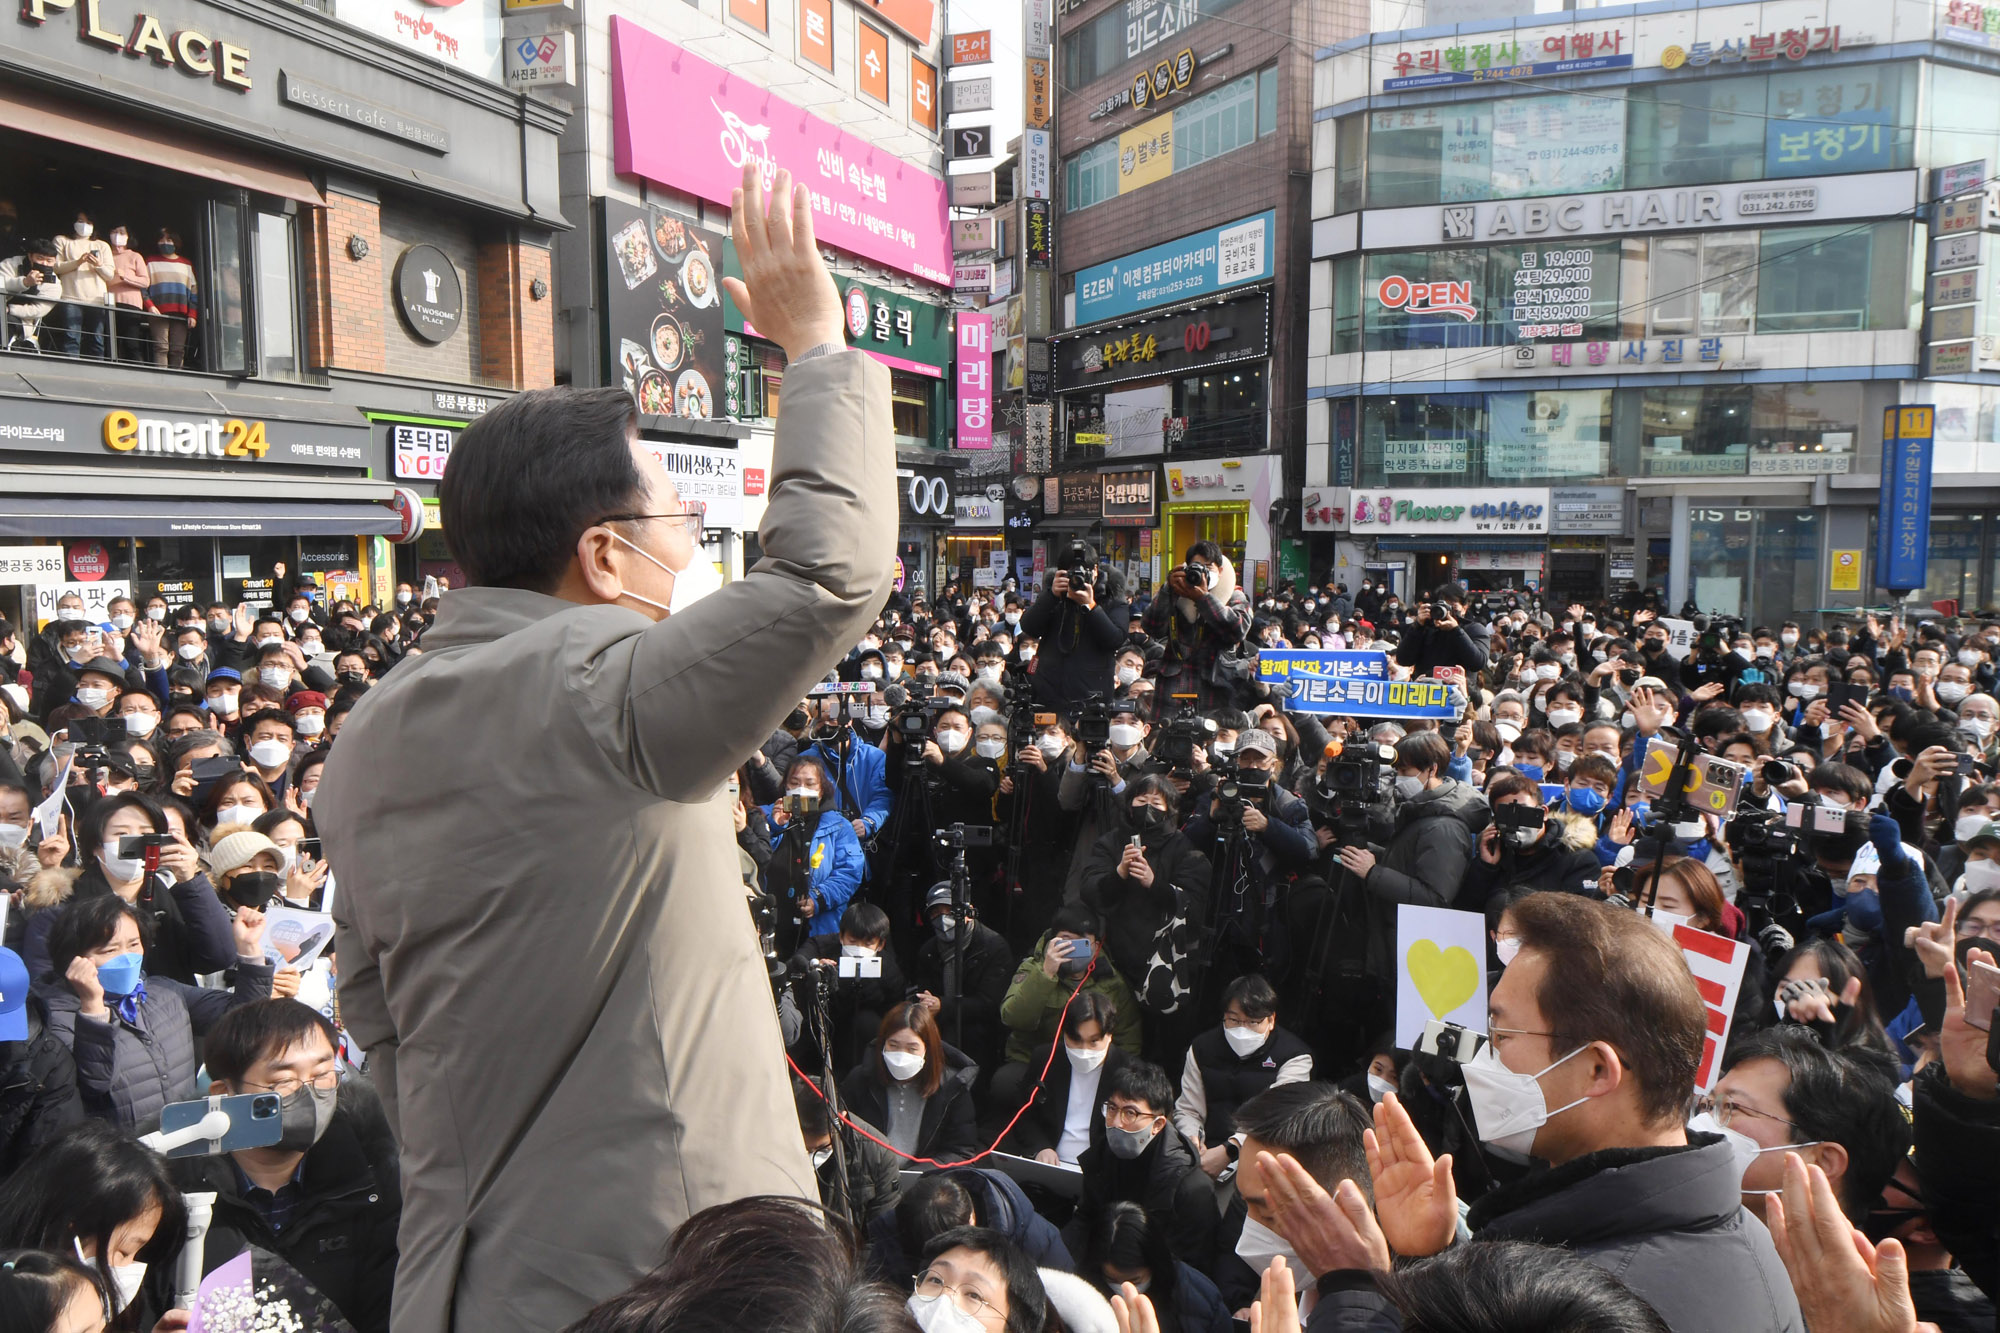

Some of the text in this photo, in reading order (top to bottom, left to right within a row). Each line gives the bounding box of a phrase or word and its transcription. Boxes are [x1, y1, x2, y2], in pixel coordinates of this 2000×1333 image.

[806, 7, 825, 47] 폰
[956, 36, 989, 54] 모아
[1542, 29, 1624, 61] 여행사
[1688, 24, 1841, 66] 동산 보청기
[864, 48, 881, 78] 수
[1485, 66, 1534, 80] 244-4978
[511, 68, 538, 81] 사진관
[916, 79, 931, 111] 리
[1099, 88, 1130, 116] 만화카페
[1135, 77, 1147, 105] 벌
[291, 84, 447, 147] dessert cafe 투썸플레이스
[1777, 122, 1881, 163] 보청기
[817, 147, 845, 184] 신비
[848, 163, 888, 204] 속눈썹
[838, 203, 856, 226] 연장
[863, 214, 895, 241] 네일아트
[1488, 189, 1722, 237] ABC HAIR
[1521, 252, 1537, 268] 펌
[1082, 245, 1216, 300] EZEN 이젠컴퓨터아카데미
[1514, 271, 1542, 285] 셋팅
[1514, 290, 1543, 305] 염색
[416, 304, 455, 321] TWOSOME
[422, 315, 444, 326] PLACE
[873, 300, 912, 347] 홀릭
[1513, 307, 1543, 322] 매직
[1518, 323, 1583, 338] 기장추가 없음
[1551, 337, 1723, 366] 태양 사진관
[961, 322, 990, 430] 마라탕
[436, 393, 487, 413] 명품 부동산
[1906, 411, 1925, 429] 11
[0, 410, 361, 459] 라이프스타일 emart24 이마트 편의점 수원역
[398, 427, 451, 454] 폰닥터
[667, 452, 737, 478] 피어싱&굿즈
[1105, 482, 1151, 504] 육쌈냉면
[1900, 441, 1922, 561] 수원역지하도상가
[1395, 500, 1466, 522] Flower
[171, 523, 182, 531] New
[36, 557, 62, 572] 365
[73, 554, 98, 564] Lotto
[301, 551, 350, 563] Accessories
[158, 581, 194, 592] emart24
[242, 579, 274, 589] emart24
[1259, 659, 1289, 677] 함께
[1323, 660, 1384, 678] 기본소득
[1292, 679, 1449, 708] 기본소득이 미래다
